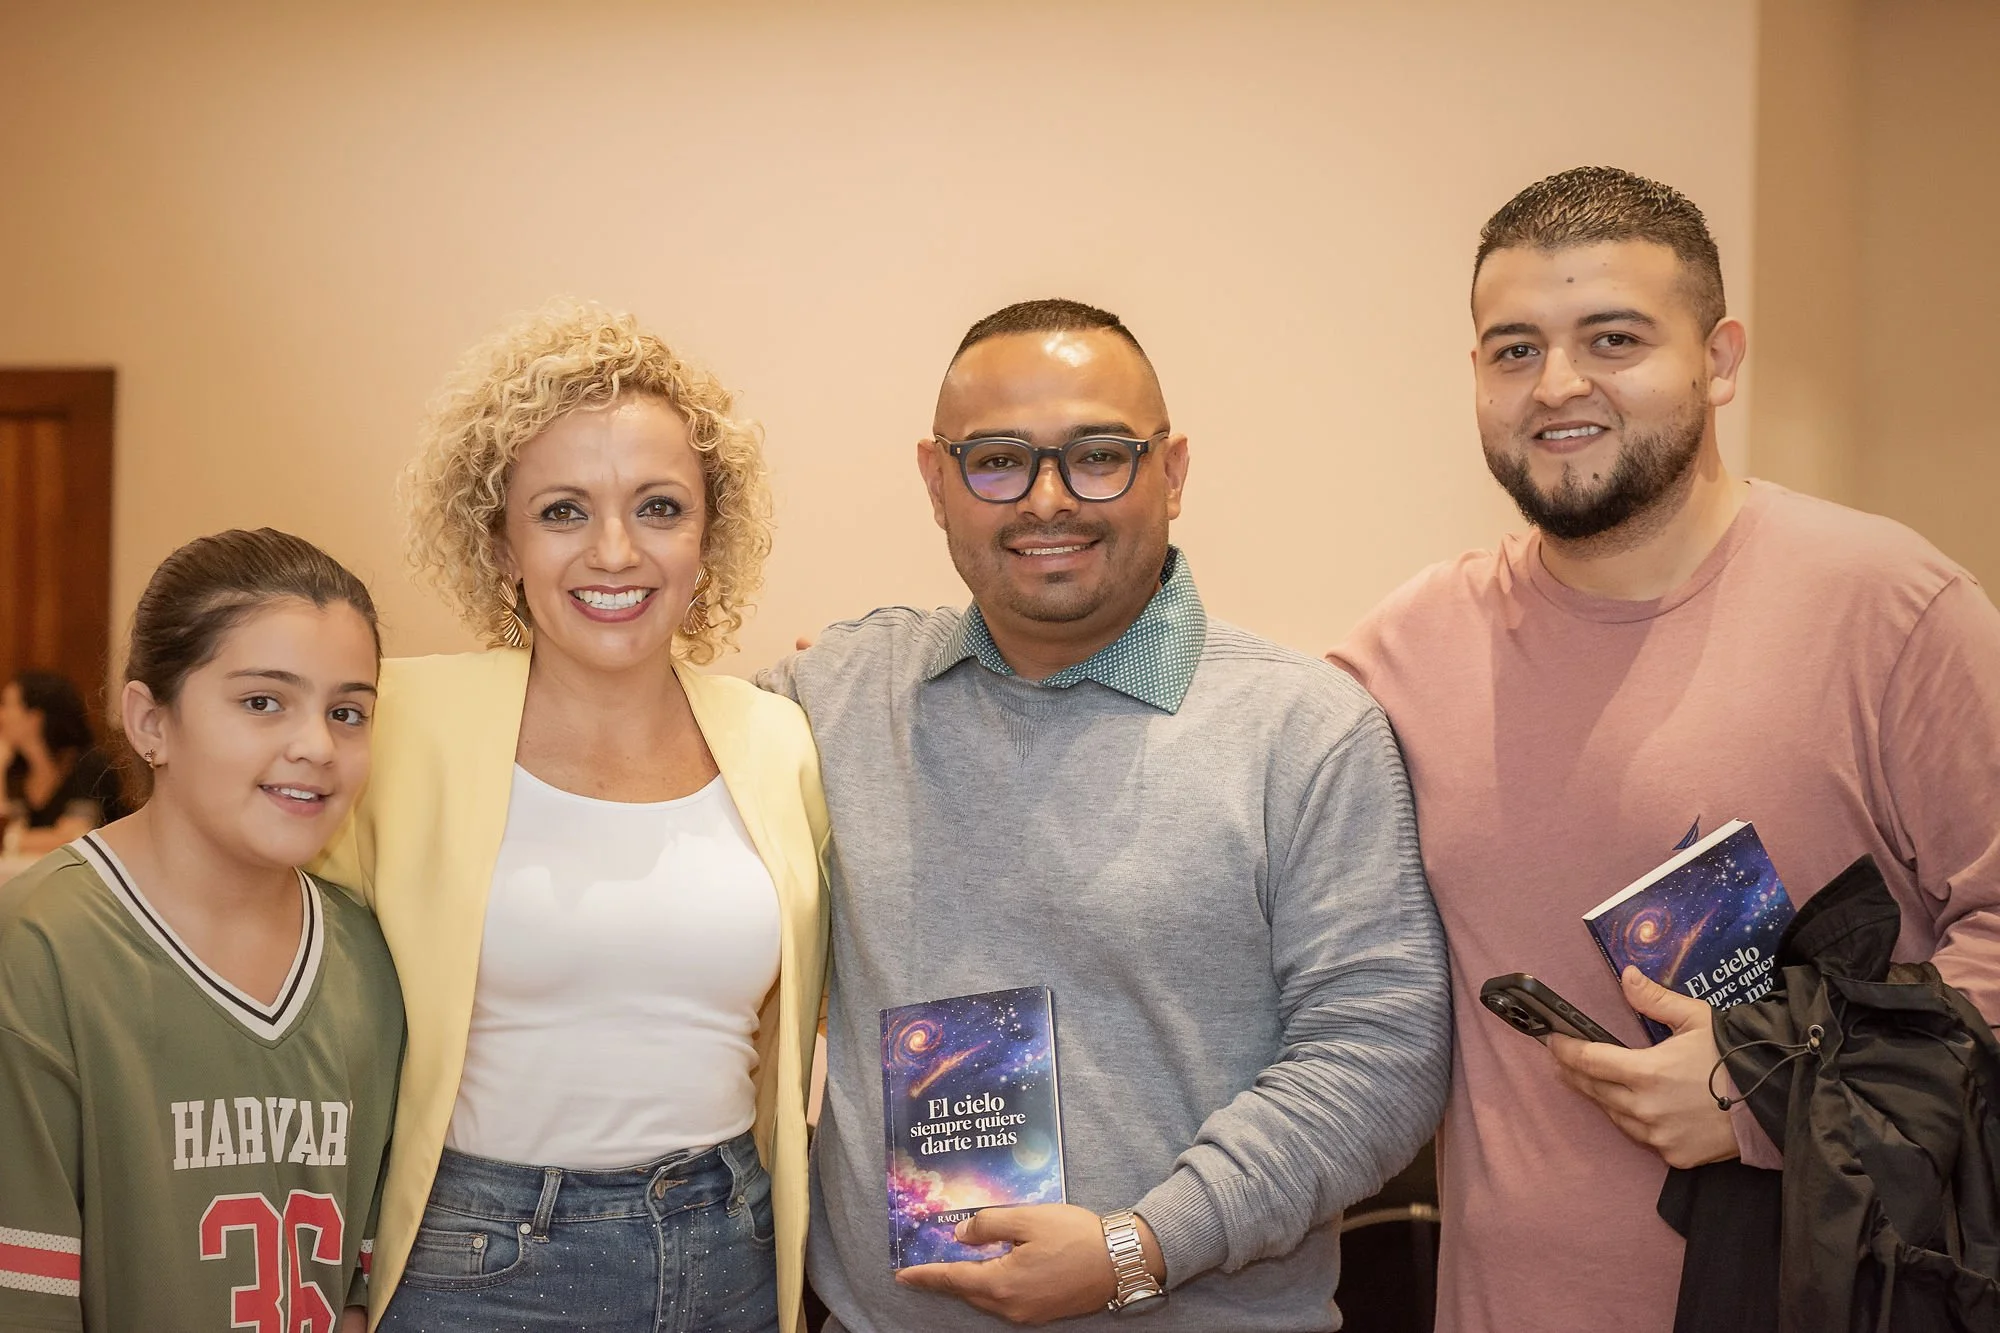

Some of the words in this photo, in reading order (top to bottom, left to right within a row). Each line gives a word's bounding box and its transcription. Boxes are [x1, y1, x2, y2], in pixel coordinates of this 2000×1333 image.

[1684, 972, 1712, 999] El
[1712, 947, 1760, 983] cielo
[1739, 955, 1775, 987] quier
[928, 1098, 949, 1119] El
[953, 1092, 1005, 1116] cielo
[171, 1096, 353, 1170] HARVAR
[910, 1119, 972, 1137] siempre
[975, 1112, 1026, 1131] quiere
[920, 1136, 972, 1155] darte
[976, 1128, 1018, 1148] más
[199, 1188, 345, 1333] 36
